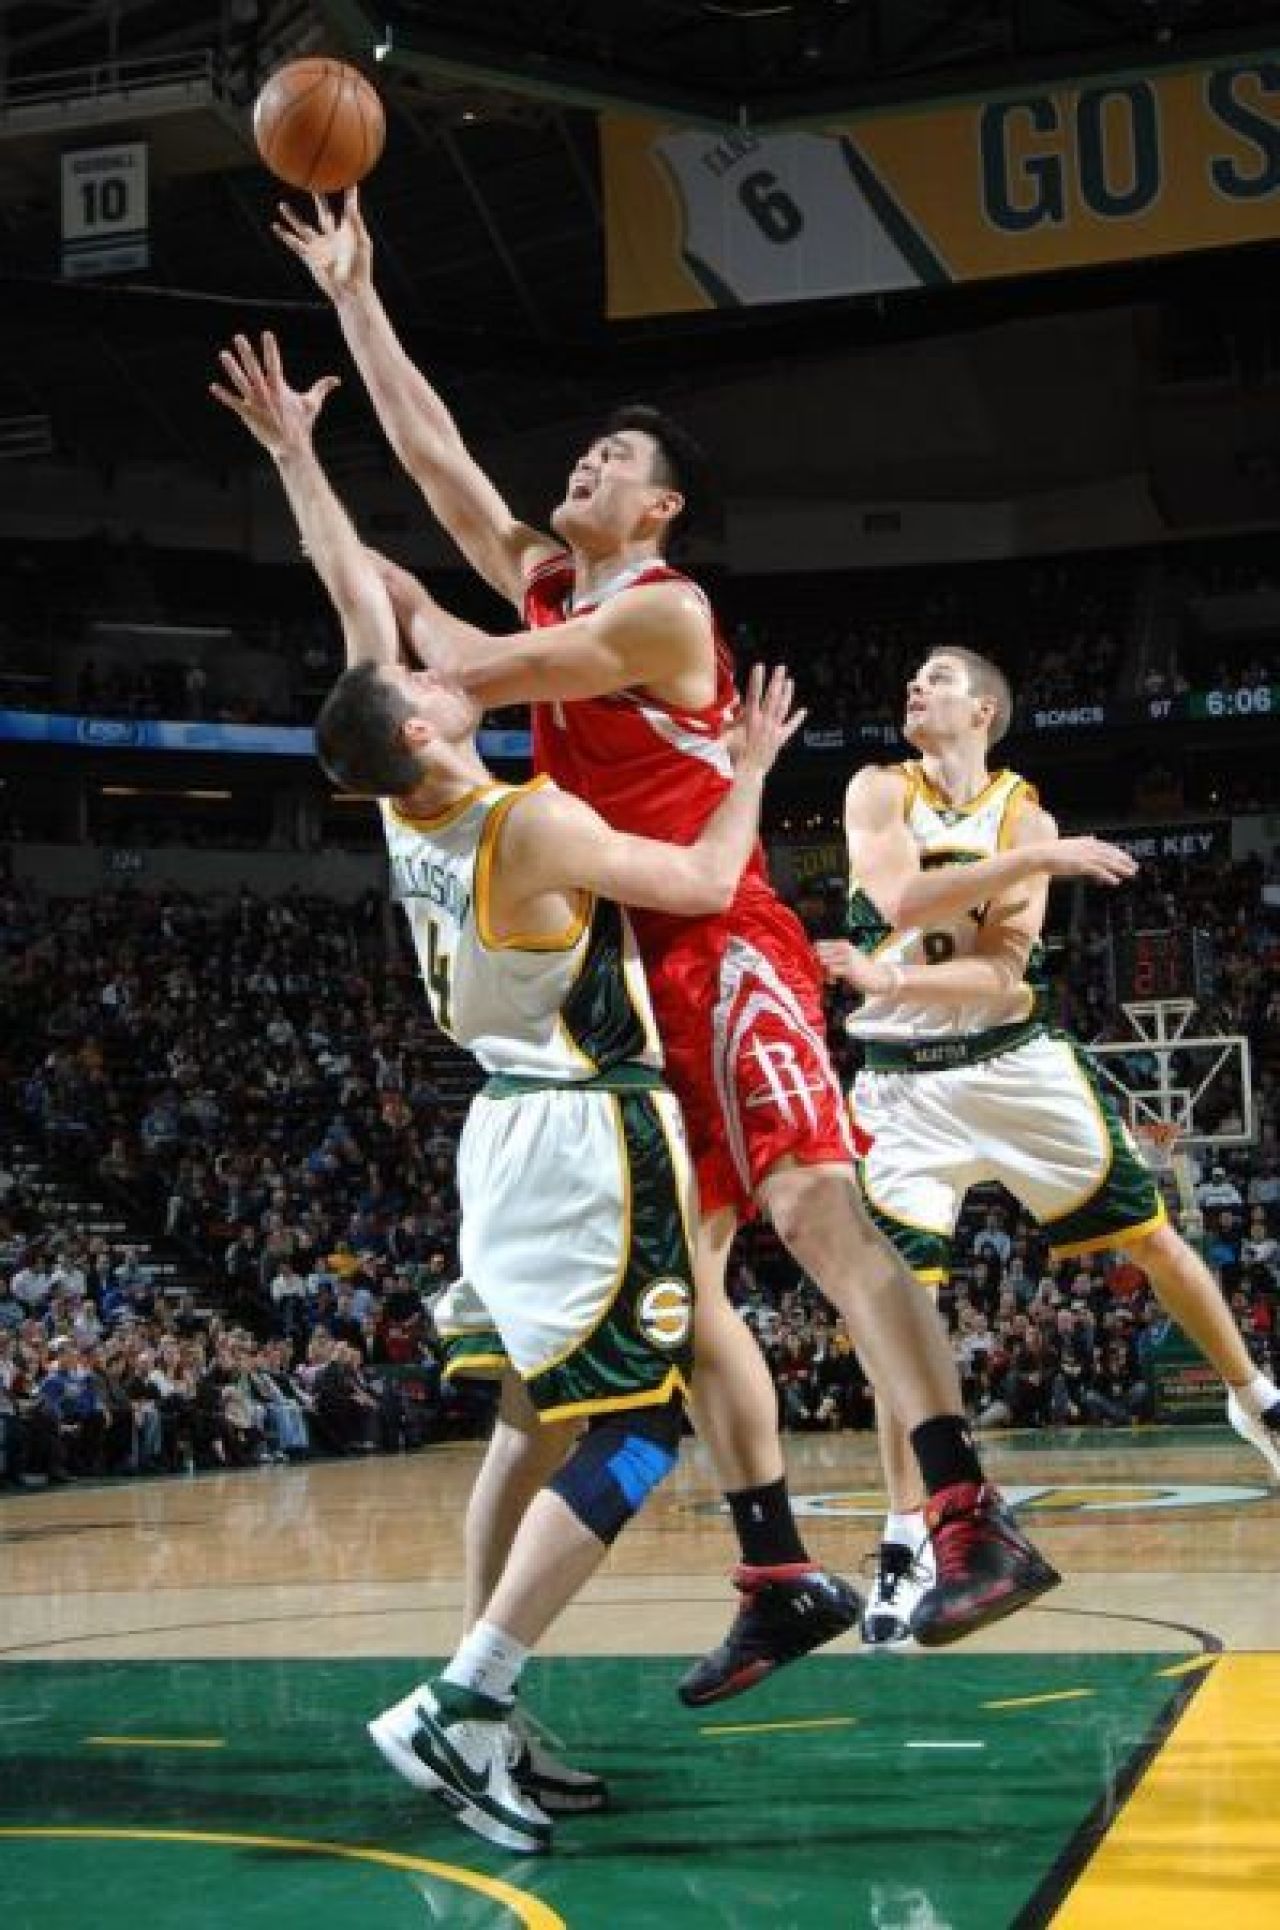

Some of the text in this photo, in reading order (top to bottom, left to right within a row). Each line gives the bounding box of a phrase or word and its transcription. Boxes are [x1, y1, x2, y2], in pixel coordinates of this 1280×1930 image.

[979, 82, 1164, 233] GO
[81, 177, 128, 226] 10
[738, 169, 804, 245] 6
[1206, 685, 1272, 716] 6:06
[1163, 832, 1214, 857] KEY
